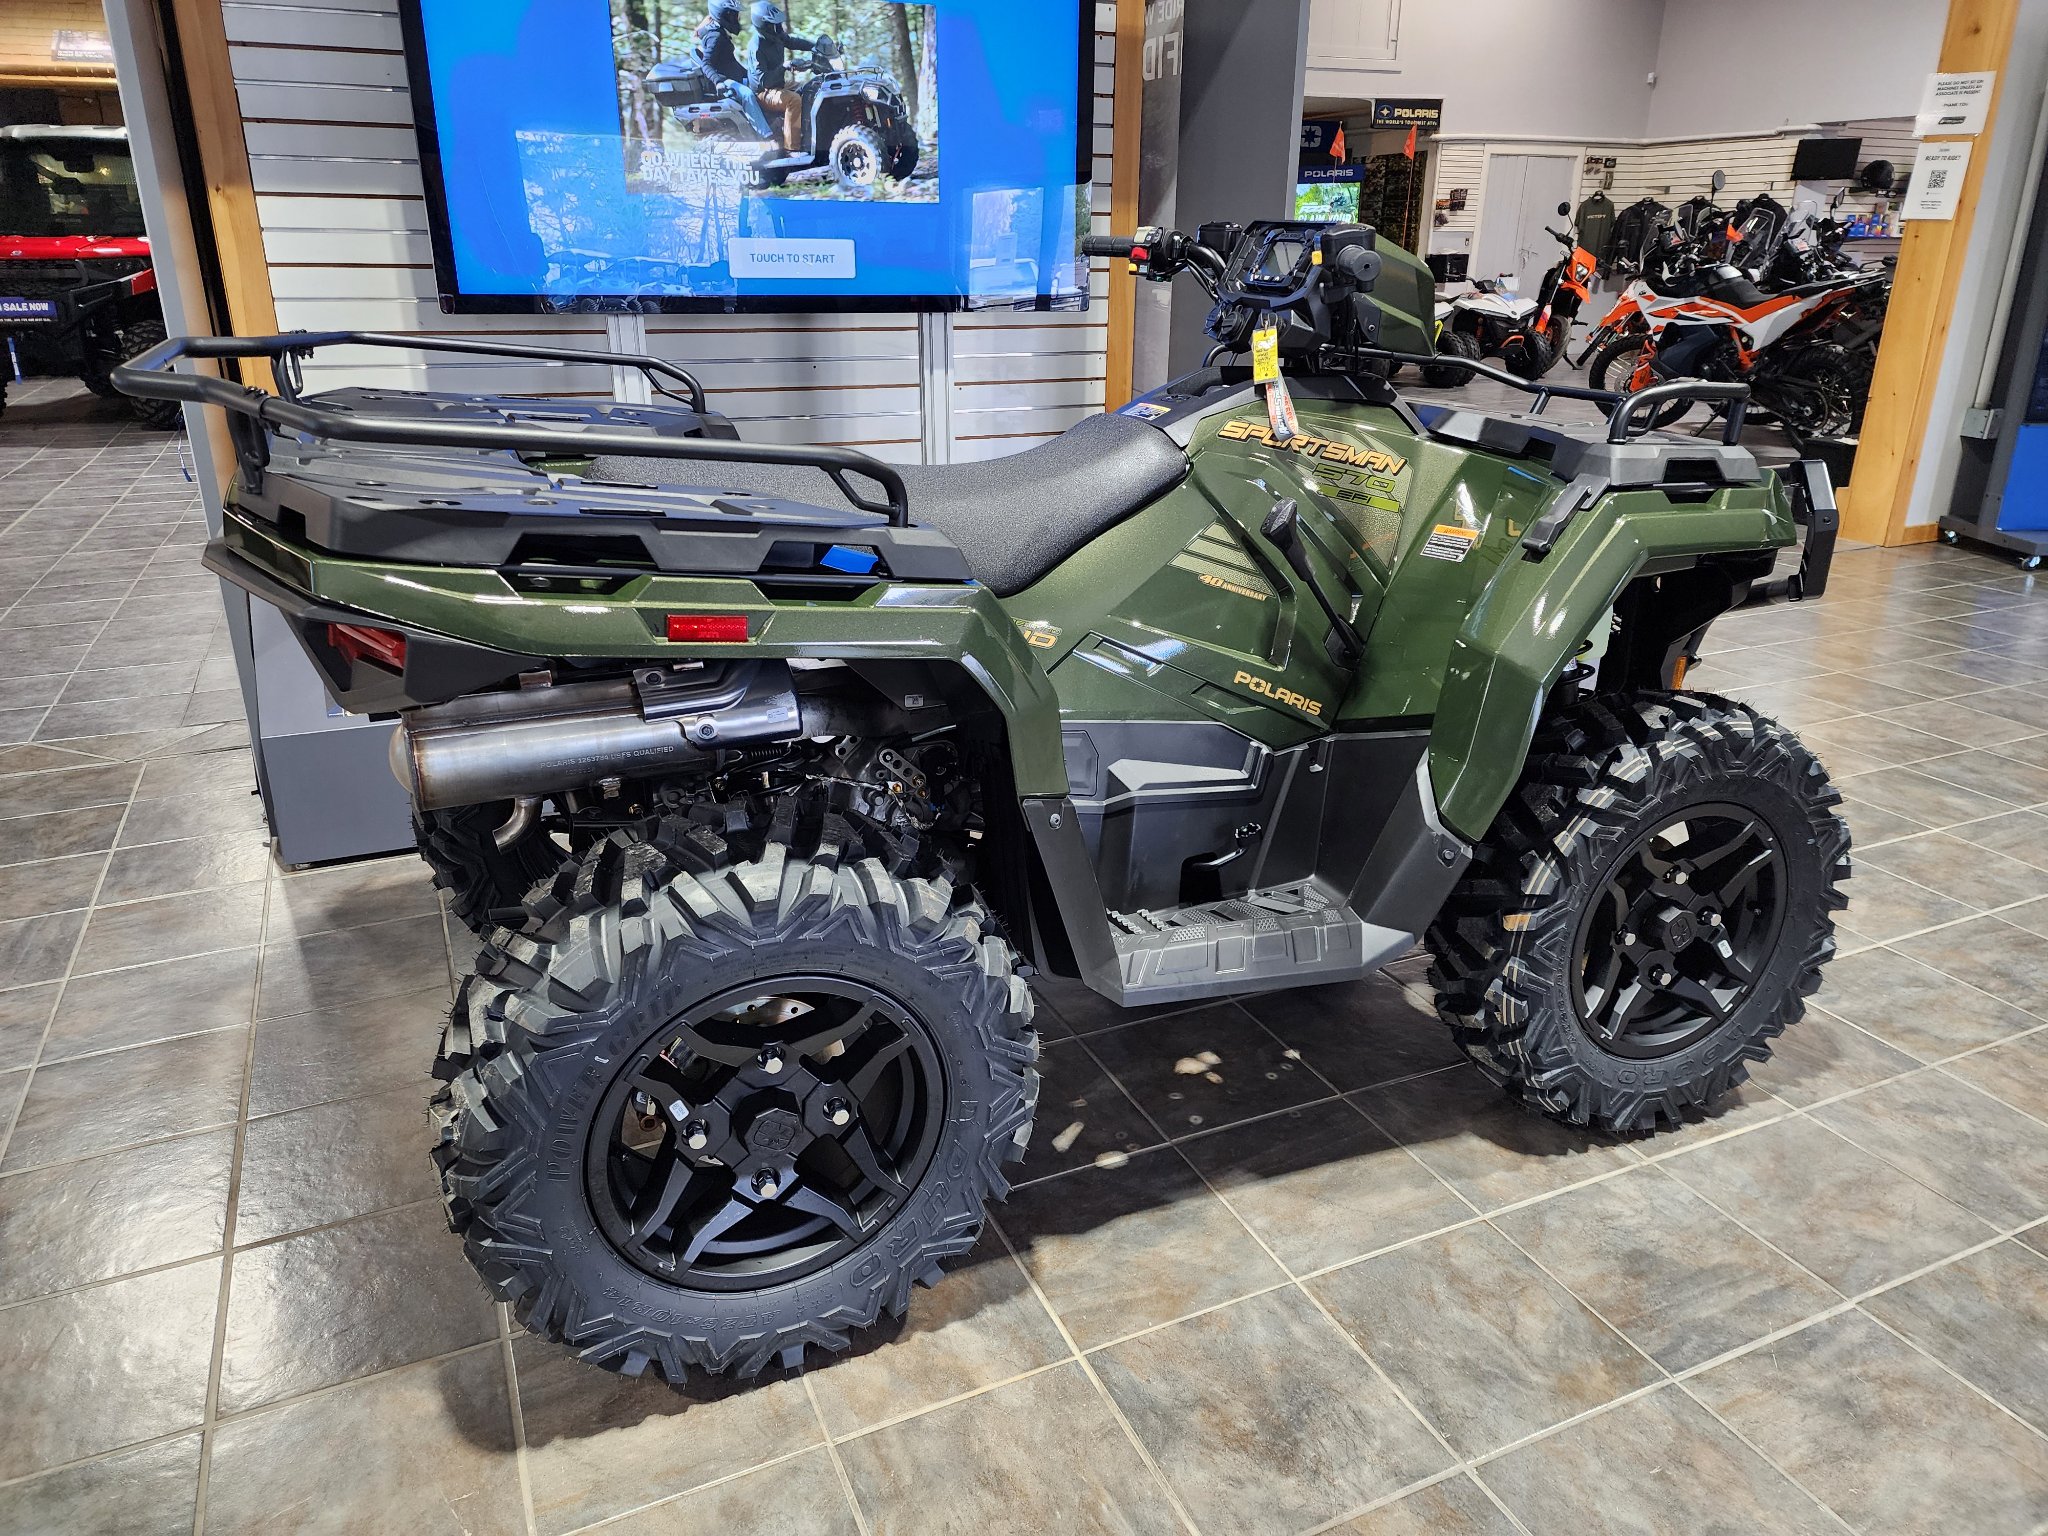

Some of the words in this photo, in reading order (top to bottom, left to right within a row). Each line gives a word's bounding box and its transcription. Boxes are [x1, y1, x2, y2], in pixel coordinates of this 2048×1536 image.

[1394, 108, 1439, 119] POLARIS
[664, 152, 720, 170] WHERE
[641, 165, 672, 182] DAY
[729, 169, 760, 186] YOU
[1304, 169, 1354, 178] POLARIS
[750, 253, 784, 263] TOUCH
[786, 253, 800, 263] TO
[802, 254, 835, 264] START
[2, 302, 29, 312] SALE
[29, 302, 49, 311] NOW
[1217, 420, 1407, 477] SPORTSMAN
[1312, 463, 1396, 493] 570
[1336, 489, 1372, 504] EFI
[1199, 574, 1224, 588] 40
[1221, 582, 1268, 602] ANNIVERSARY
[1233, 670, 1323, 717] POLARIS
[540, 758, 577, 769] POLARIS
[633, 745, 675, 758] QUALIFIED
[547, 1064, 601, 1183] POWER
